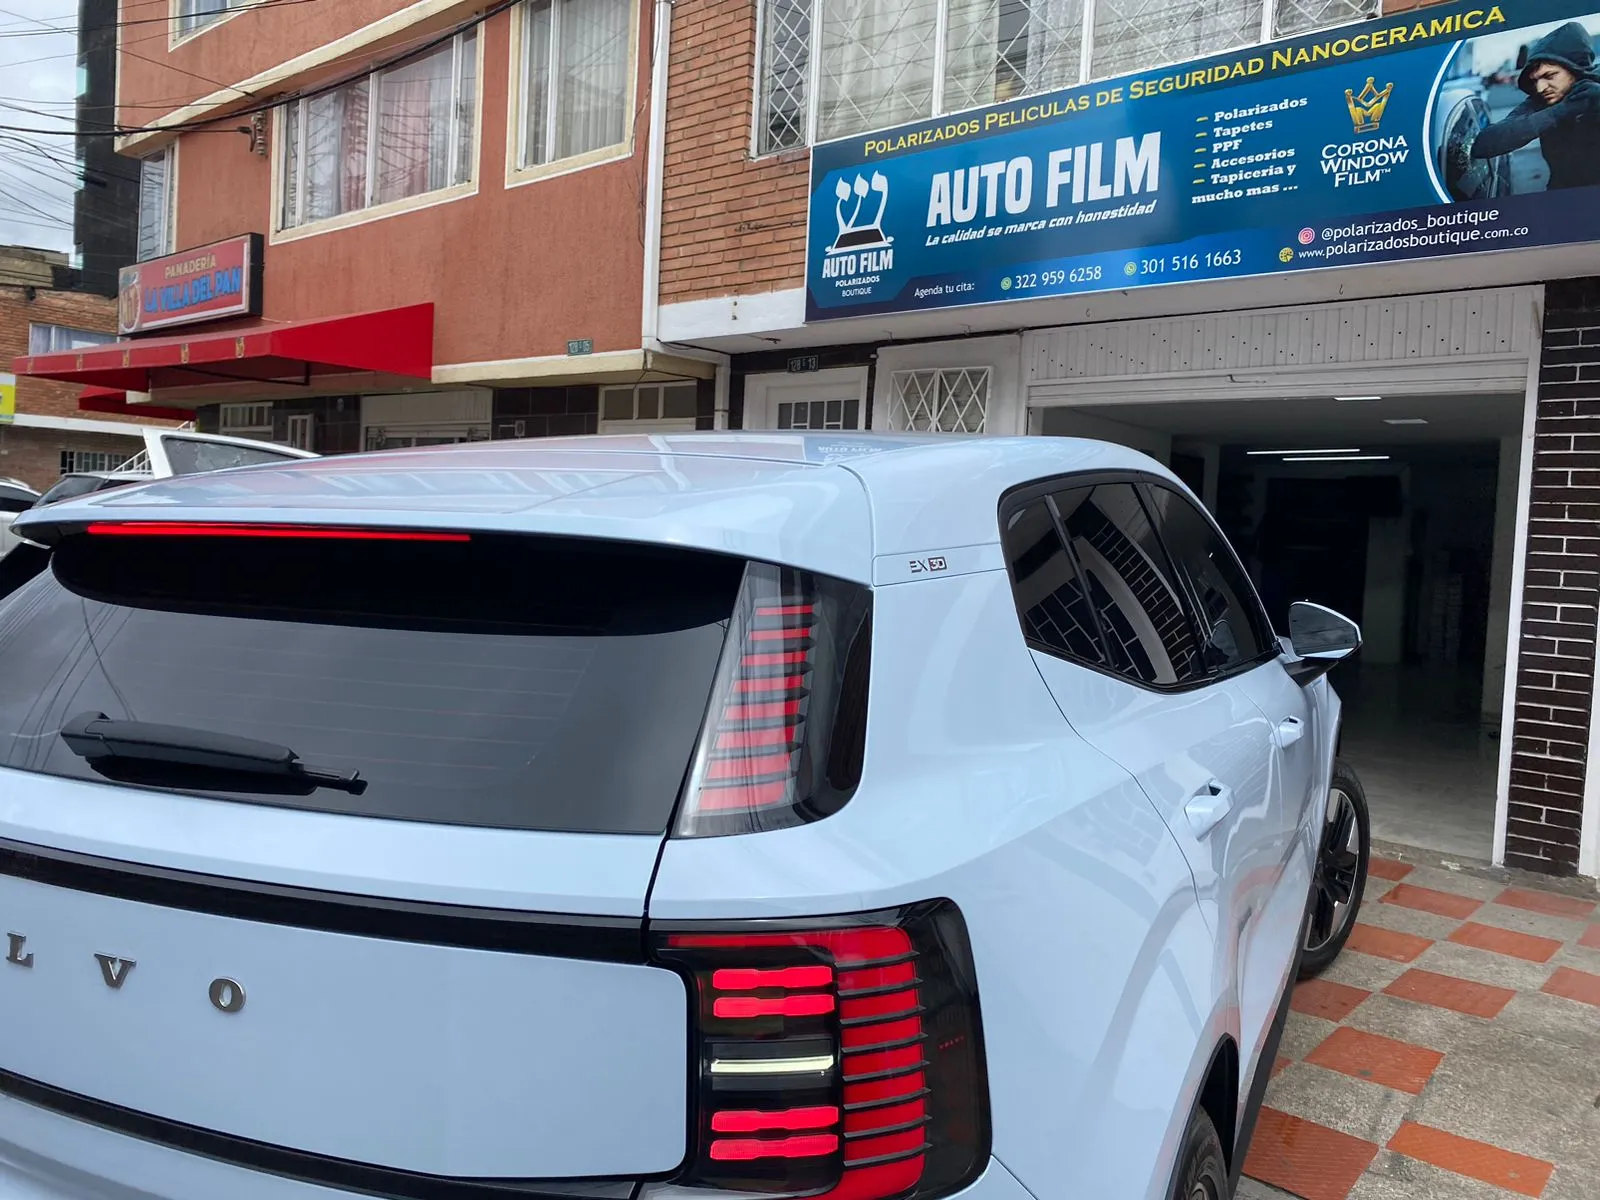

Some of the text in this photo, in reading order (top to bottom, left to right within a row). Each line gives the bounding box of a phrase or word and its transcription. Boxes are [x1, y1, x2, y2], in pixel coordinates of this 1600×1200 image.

[864, 5, 1506, 156] POLARIZADOS PELICULAS DE SEGURIDAD NANOCERAMICA
[1214, 97, 1308, 122] Polarizados
[1213, 120, 1273, 137] Tapetes
[1211, 148, 1296, 169] Accesorios
[1212, 139, 1243, 154] PPF
[1322, 135, 1408, 159] CORONA
[1320, 149, 1409, 174] WINDOW
[926, 131, 1162, 227] AUTO FILM
[1211, 164, 1297, 184] Tapiceria y
[1191, 189, 1243, 204] mucho
[1246, 184, 1280, 196] mas
[925, 200, 1158, 247] La calidad se marca con honestidad
[1321, 208, 1500, 242] @polarizados_boutique
[1298, 224, 1529, 259] www.polarizadosboutique.com.co
[822, 249, 894, 278] AUTO FILM
[1140, 249, 1242, 275] 301 516 1663
[835, 275, 880, 287] POLARIZADOS
[1014, 265, 1102, 289] 322 959 6258
[144, 266, 242, 314] LA VILLA DEL PAN
[841, 287, 872, 297] BOUTIQUE
[914, 282, 975, 299] Agenda tu cita:
